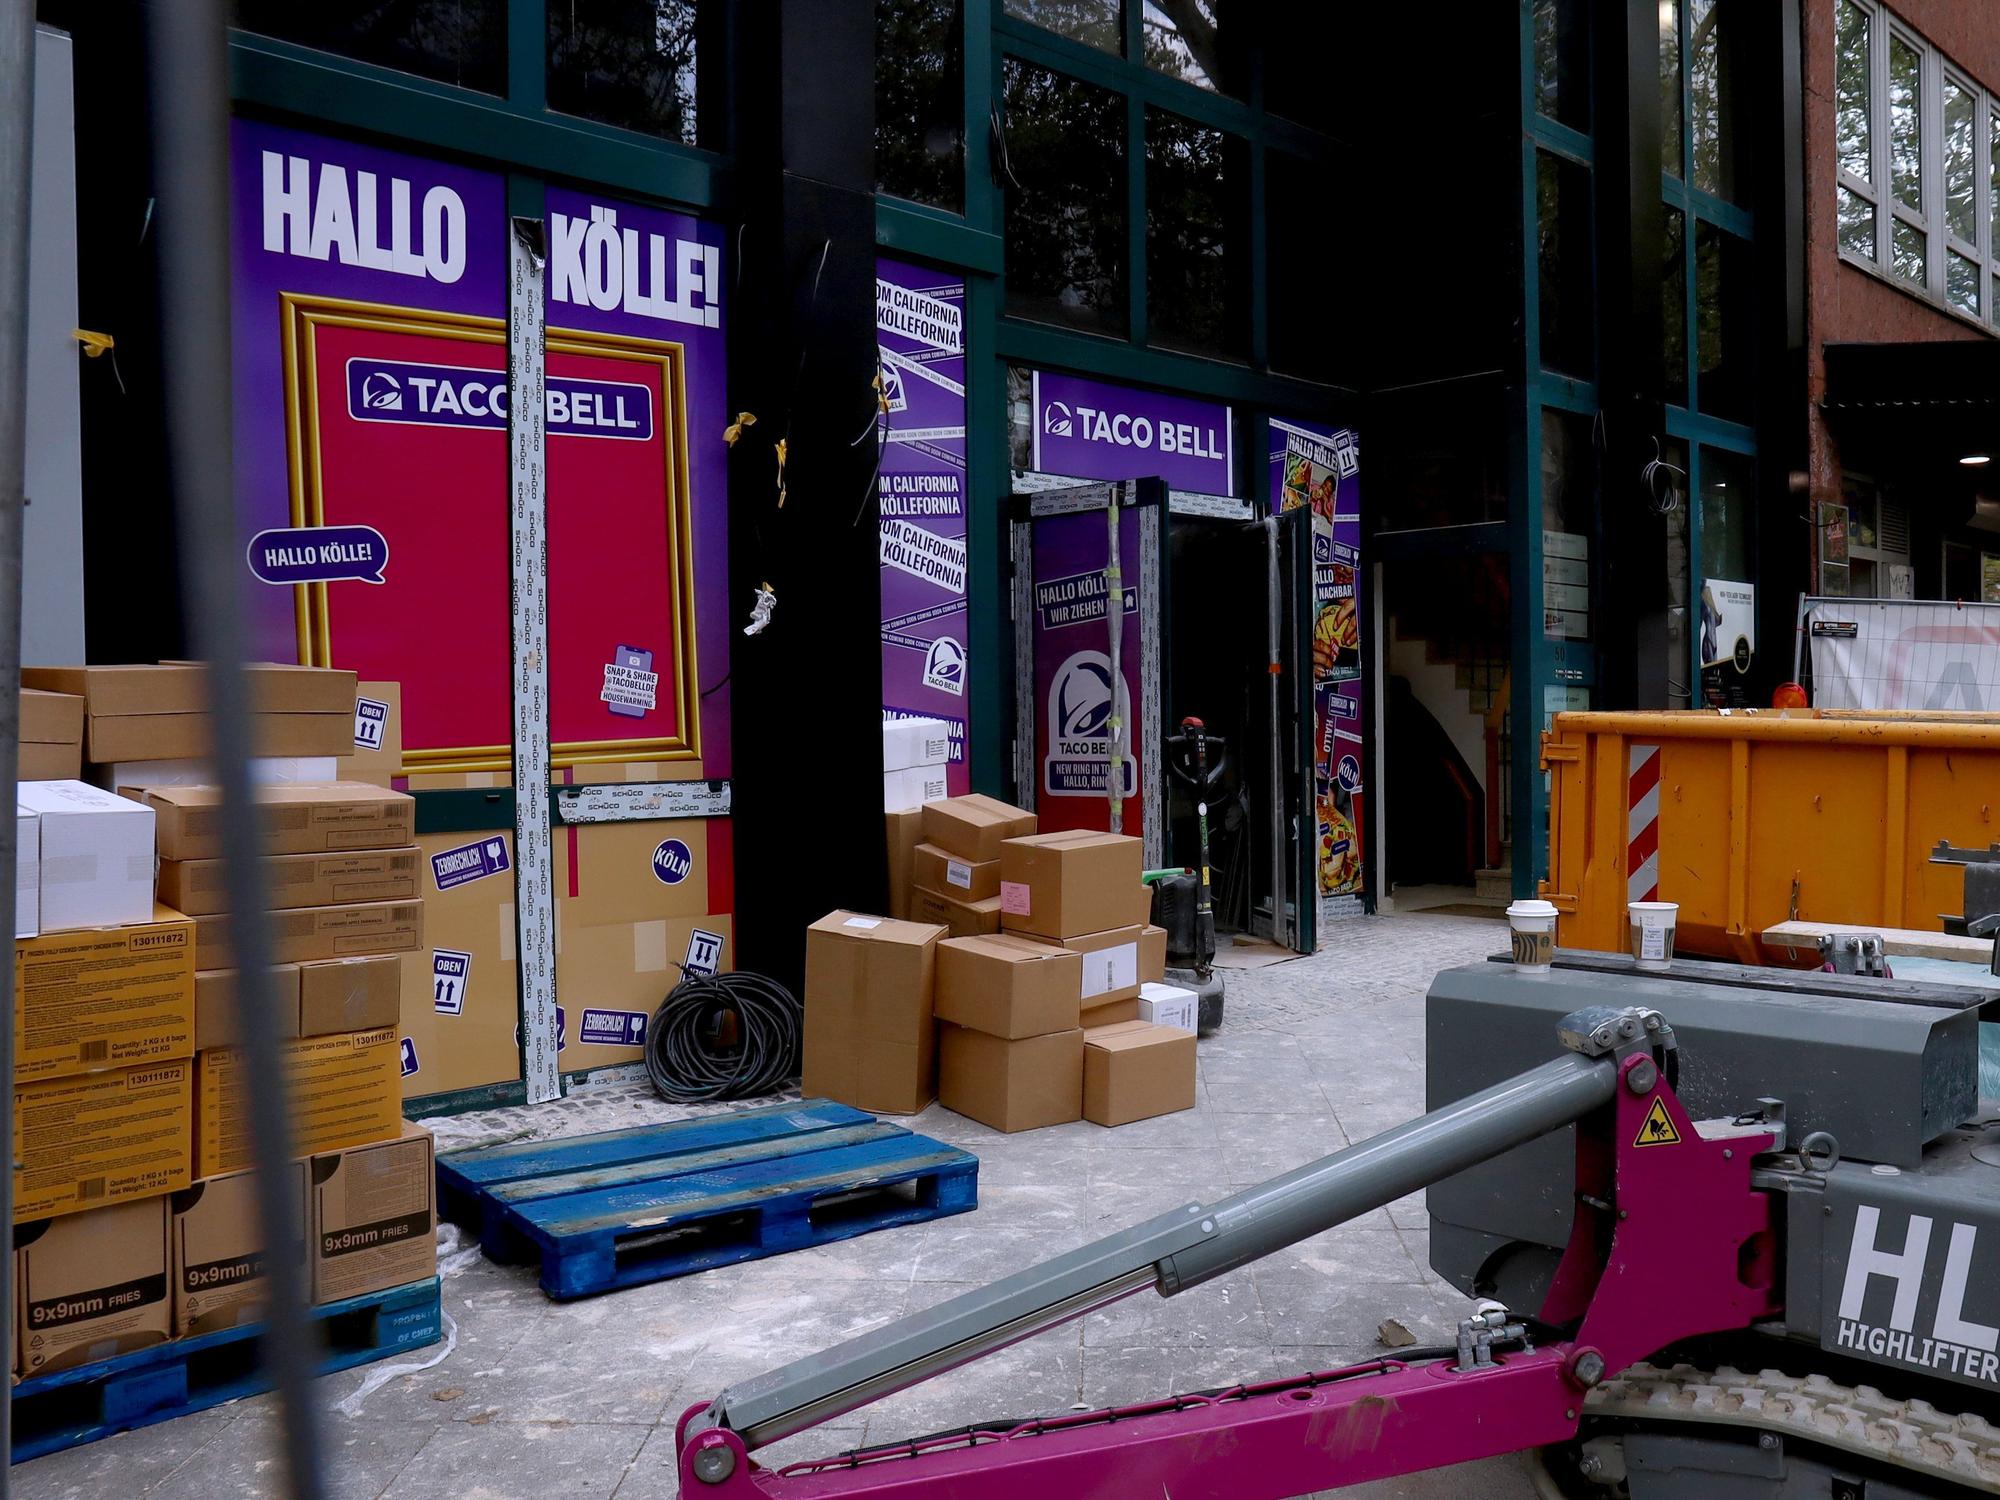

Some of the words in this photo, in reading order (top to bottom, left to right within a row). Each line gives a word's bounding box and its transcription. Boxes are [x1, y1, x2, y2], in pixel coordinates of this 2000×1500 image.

[262, 150, 466, 284] HALLO
[551, 204, 720, 329] KÖLLE!
[895, 291, 958, 326] CALIFORNIA
[878, 305, 956, 348] KÖLLEFORNIA
[546, 390, 637, 428] BELL
[889, 401, 903, 409] ELL
[1076, 406, 1153, 448] TACO
[1160, 420, 1223, 460] BELL
[1288, 433, 1314, 460] HALLO
[893, 476, 959, 492] CALIFORNIA
[880, 494, 960, 515] KÖLLEFORNIA
[264, 546, 317, 567] HALLO
[320, 542, 372, 564] KÖLLE!
[903, 528, 965, 568] CALIFORNIA
[884, 541, 961, 588] KÖLLEFORNIA
[1315, 569, 1334, 584] ALLO
[1040, 582, 1075, 605] HALLO
[1318, 584, 1353, 600] NACHBAR
[1050, 606, 1070, 623] WIR
[1070, 599, 1105, 620] ZIEHEN
[606, 666, 626, 676] SNAP
[626, 670, 631, 678] &
[633, 671, 656, 683] SHARE
[606, 676, 654, 692] @TACOBELLDE
[928, 676, 943, 686] TACO
[944, 682, 959, 692] BELL
[603, 692, 652, 707] HOUSEWARMING
[362, 706, 381, 718] OBEN
[1323, 719, 1334, 753] HALLO
[1059, 743, 1089, 754] TACO
[1056, 763, 1072, 775] NEW
[1073, 763, 1090, 775] RING
[1091, 763, 1100, 775] IN
[1340, 760, 1358, 785] KÖLN
[1063, 775, 1090, 789] HALLO,
[1091, 775, 1106, 788] RIN
[435, 848, 482, 876] ZERBRECHLICH
[654, 848, 689, 877] KÖLN
[133, 934, 183, 946] 130111872
[436, 960, 462, 973] OBEN
[584, 1013, 624, 1032] ZERBRECHLICH
[112, 1041, 142, 1051] Quantity:
[357, 1032, 394, 1044] 130111872
[112, 1051, 123, 1059] Net
[124, 1049, 149, 1058] Weight:
[131, 1069, 180, 1085] 130111872
[324, 1228, 378, 1253] 9x9mm
[382, 1223, 409, 1239] FRIES
[188, 1262, 250, 1286] 9x9mm
[1838, 1204, 2000, 1352] HL
[32, 1295, 103, 1323] 9x9mm
[108, 1289, 141, 1308] FRIES
[411, 1326, 434, 1339] CHEP
[1838, 1320, 1999, 1383] HIGHLIFTER
